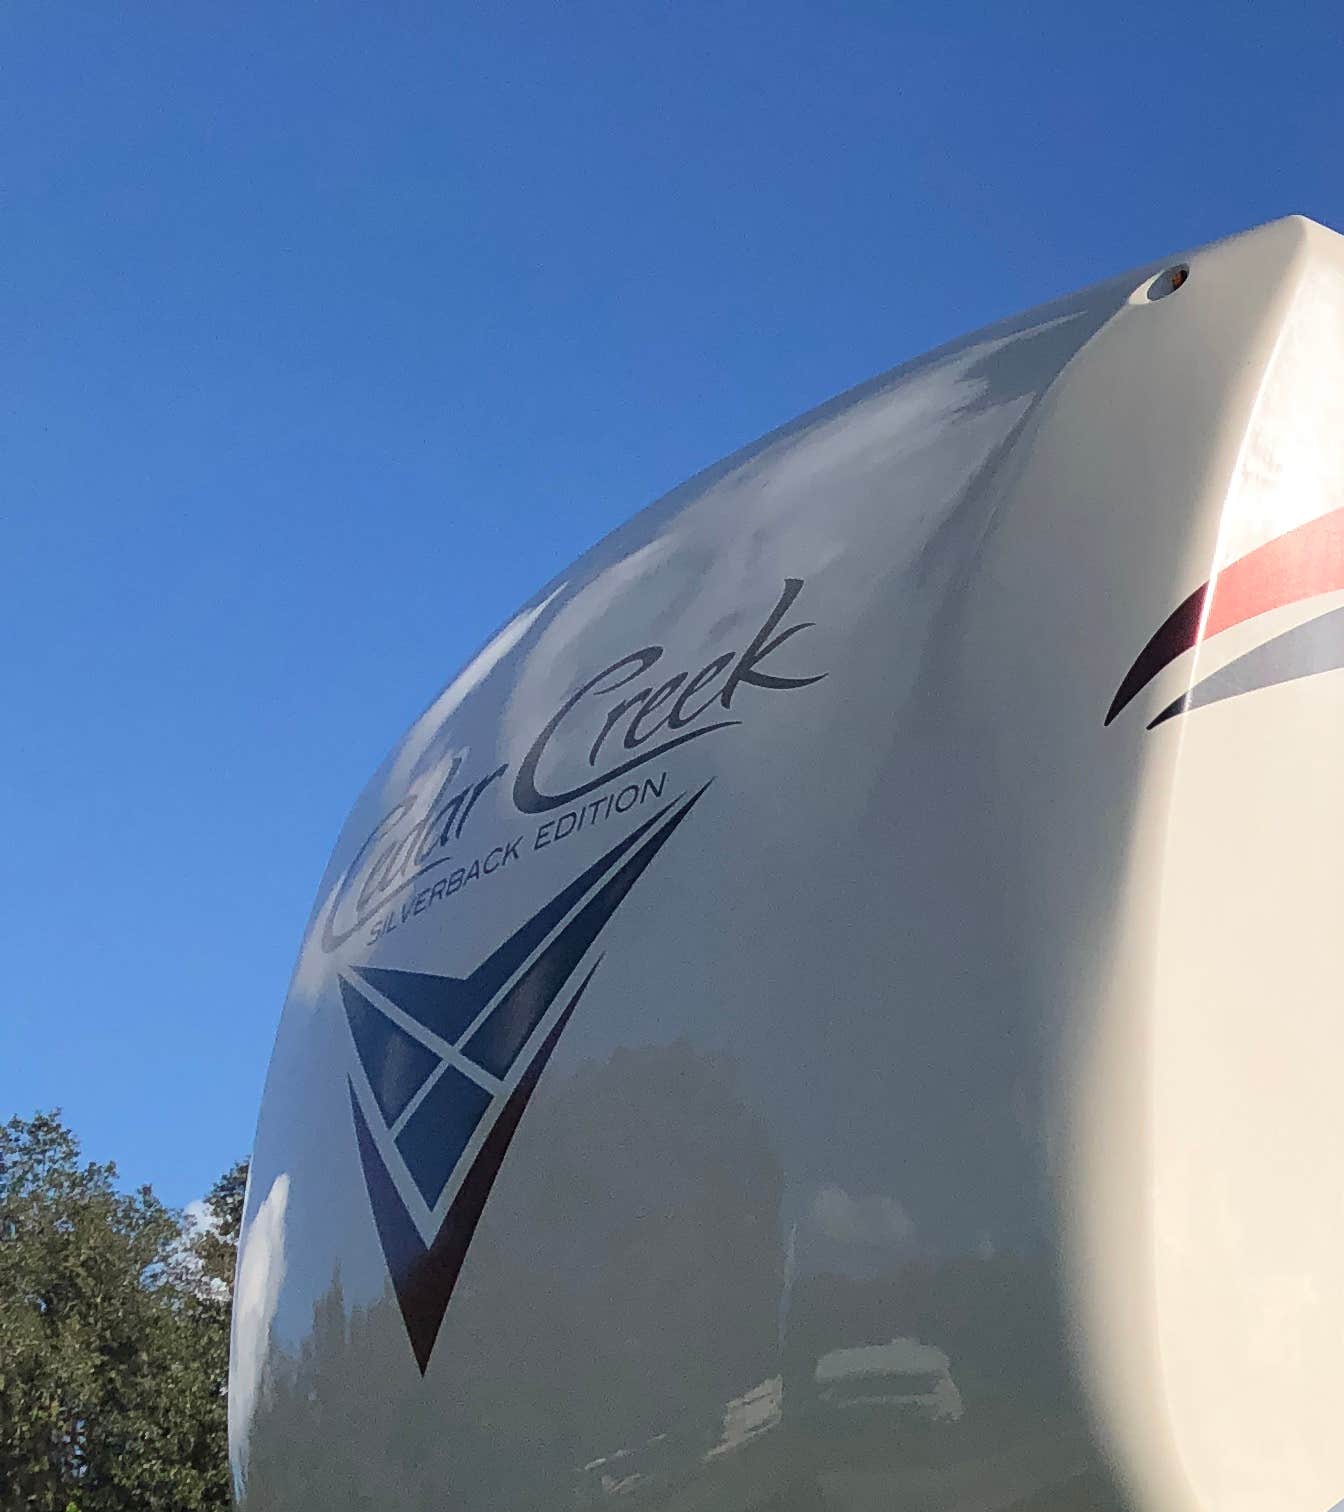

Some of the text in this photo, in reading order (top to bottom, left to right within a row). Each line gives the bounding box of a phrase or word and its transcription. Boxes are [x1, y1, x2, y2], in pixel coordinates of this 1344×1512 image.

[512, 578, 829, 814] Creek
[366, 772, 668, 947] SILVERBACK EDITION
